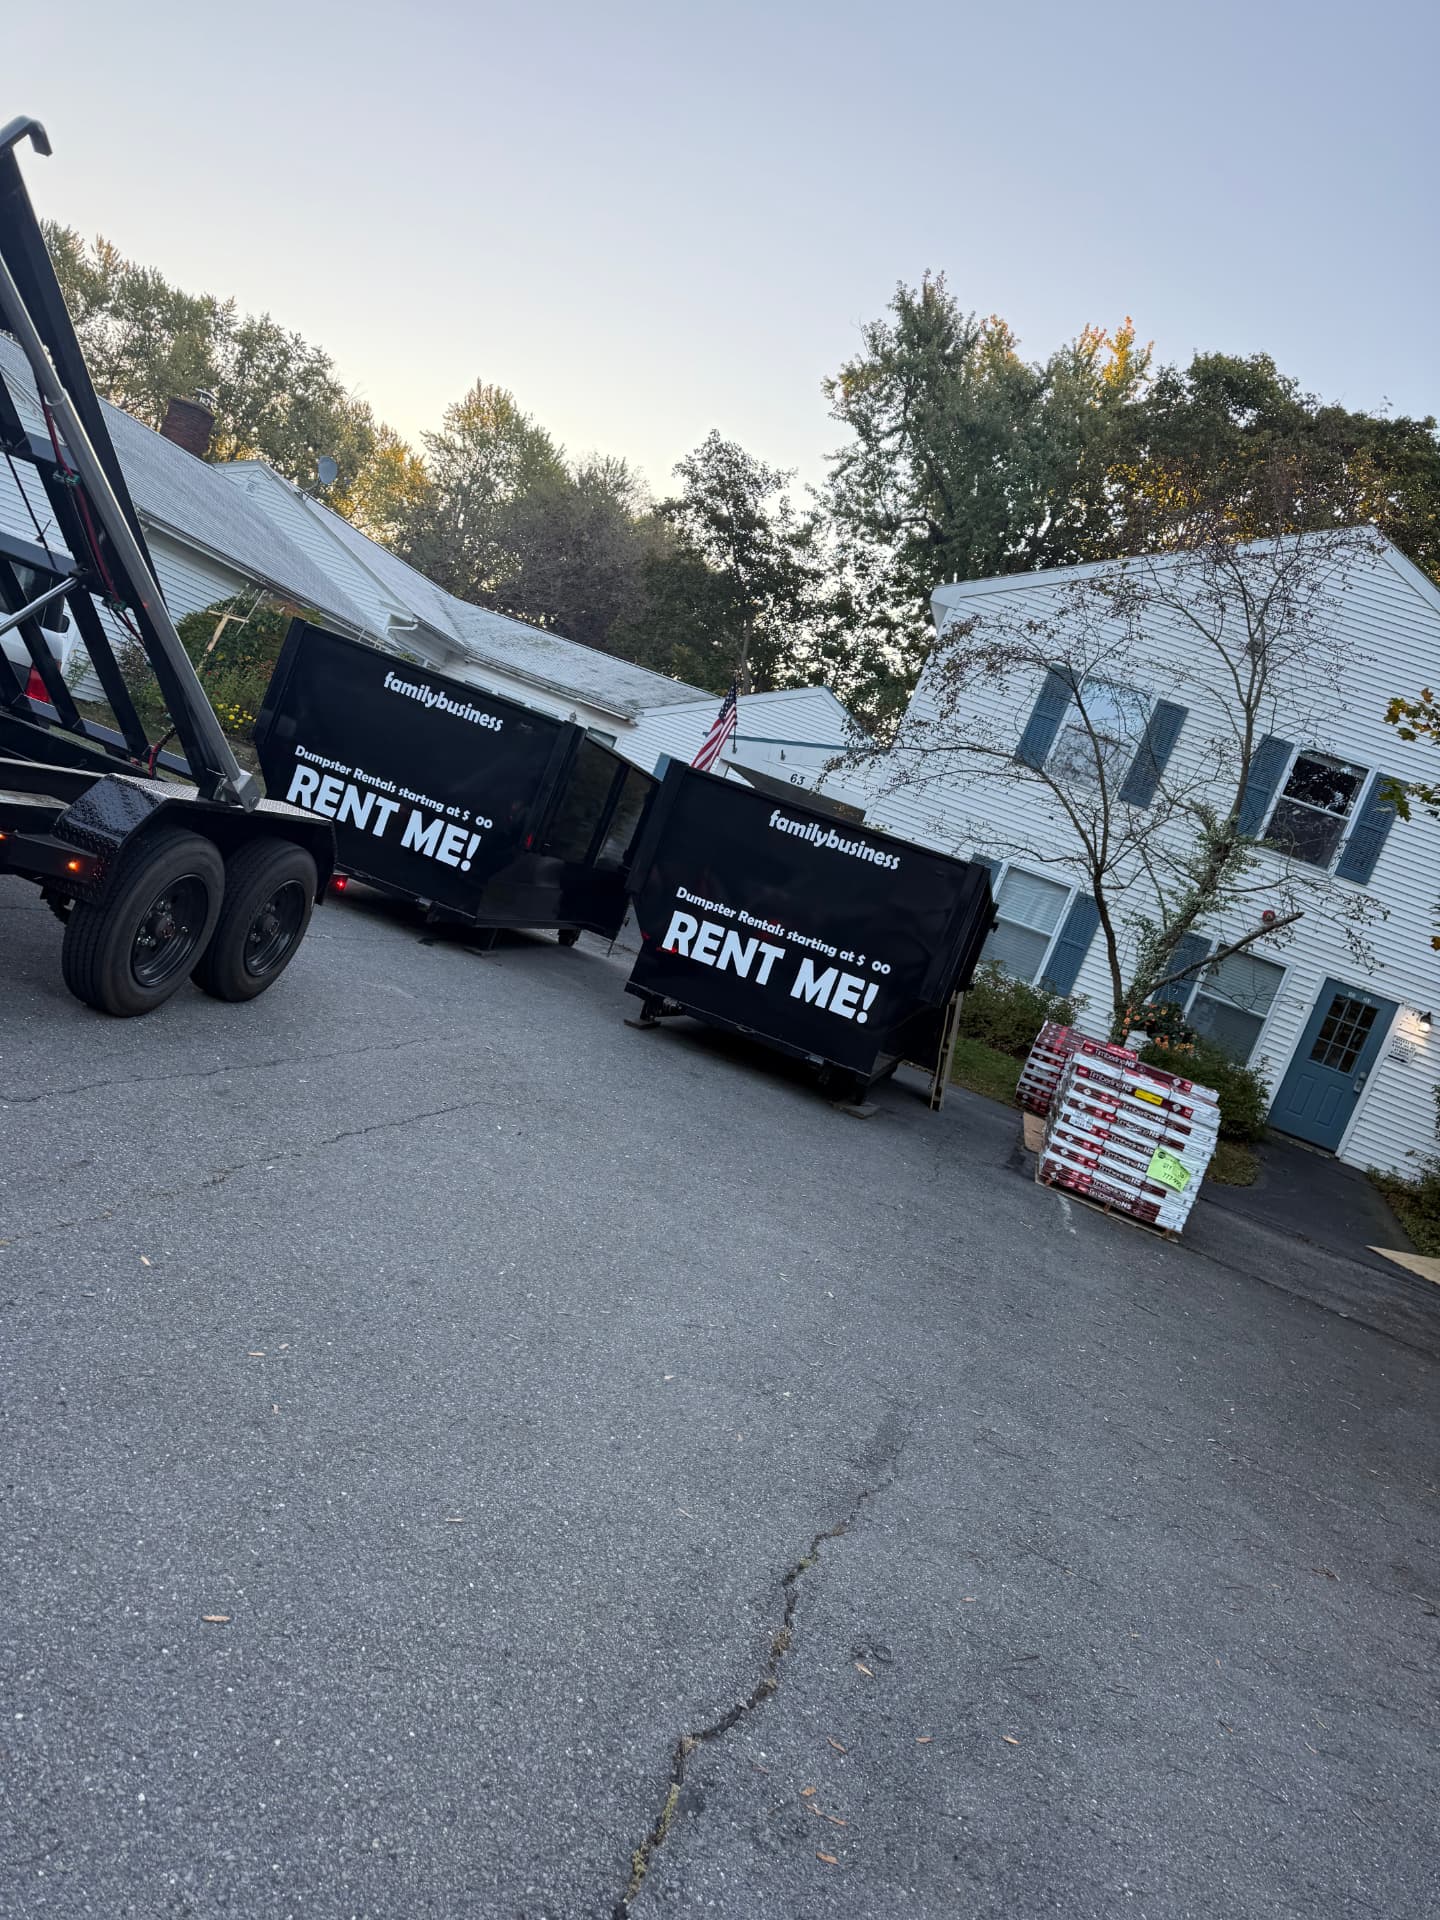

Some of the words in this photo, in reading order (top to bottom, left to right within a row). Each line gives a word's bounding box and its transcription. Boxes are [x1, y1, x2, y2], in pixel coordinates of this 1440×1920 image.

[384, 672, 504, 732] familybusiness
[295, 745, 353, 776] Dumpster
[353, 768, 397, 793] Rentals
[398, 788, 445, 813] starting
[447, 807, 461, 818] at
[461, 810, 471, 822] $
[790, 773, 806, 786] 63
[286, 765, 400, 837] RENT
[401, 810, 482, 872] ME!
[769, 810, 901, 870] familybusiness
[676, 887, 737, 918] Dumpster
[738, 910, 786, 937] Rentals
[787, 931, 838, 958] starting
[839, 951, 856, 963] at
[857, 955, 866, 967] $
[662, 911, 785, 986] RENT
[790, 958, 880, 1024] ME!
